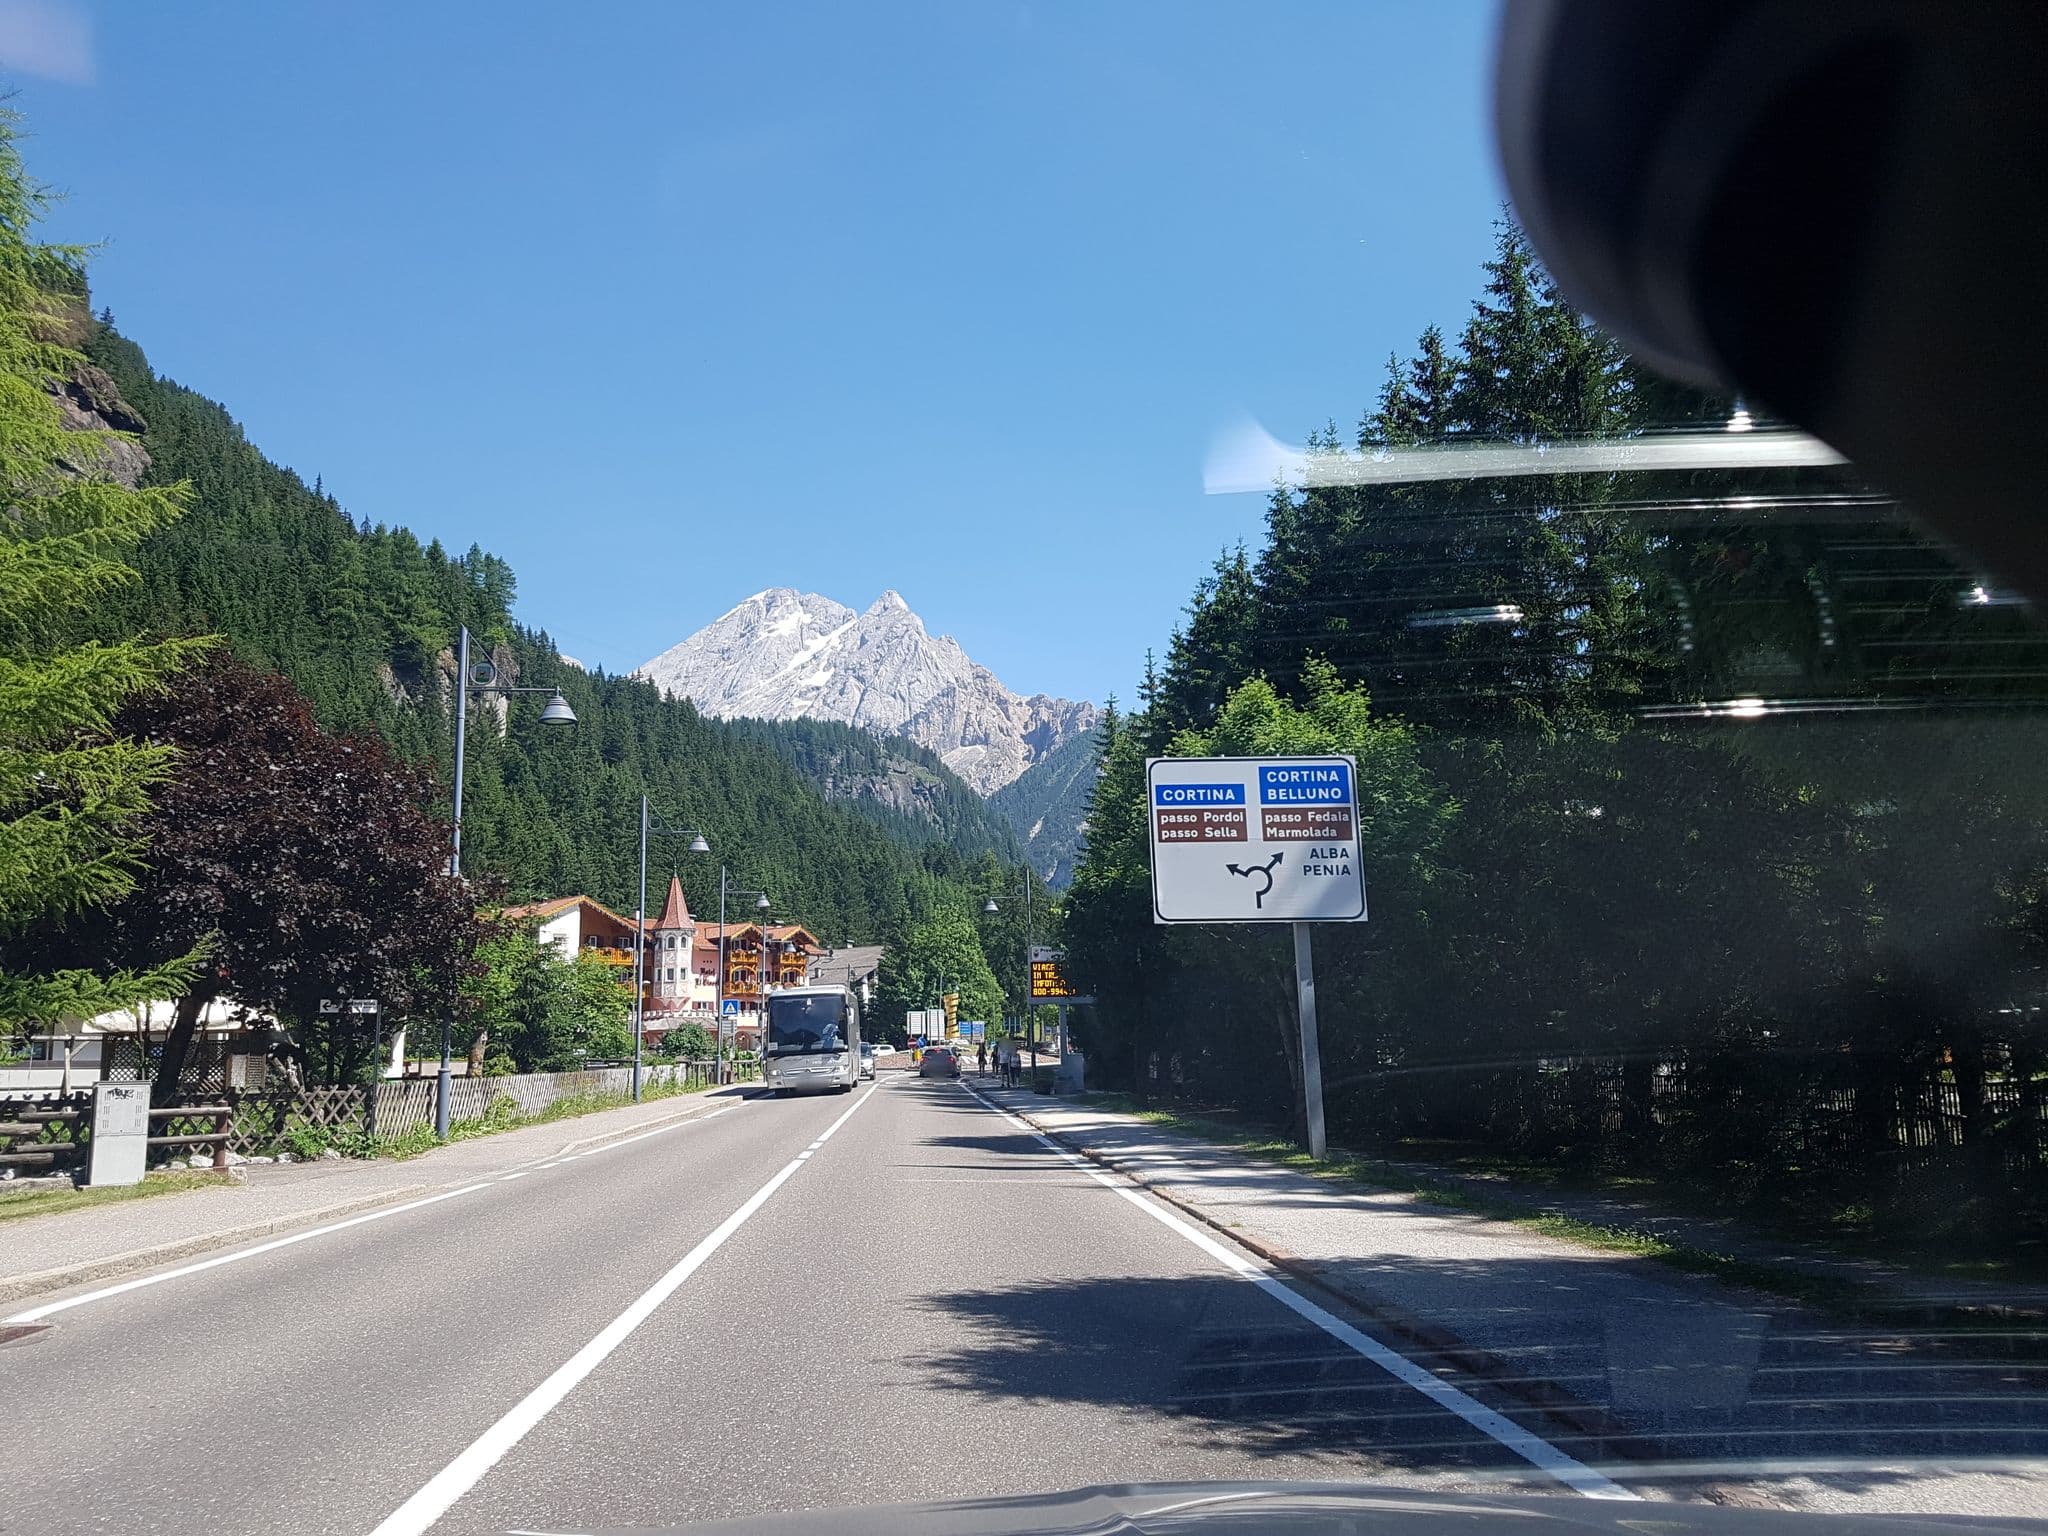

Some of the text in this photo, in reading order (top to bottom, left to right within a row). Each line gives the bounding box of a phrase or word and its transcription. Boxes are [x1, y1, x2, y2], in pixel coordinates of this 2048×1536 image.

[1266, 771, 1339, 782] CORTINA
[1162, 789, 1236, 801] CORTINA
[1267, 787, 1342, 800] BELLUNO
[1160, 814, 1198, 825] passo
[1265, 813, 1302, 824] passo
[1161, 826, 1238, 840] passo Sella
[1266, 826, 1338, 838] Marmolada
[1309, 847, 1350, 859] ALBA
[1303, 864, 1351, 876] PENIA
